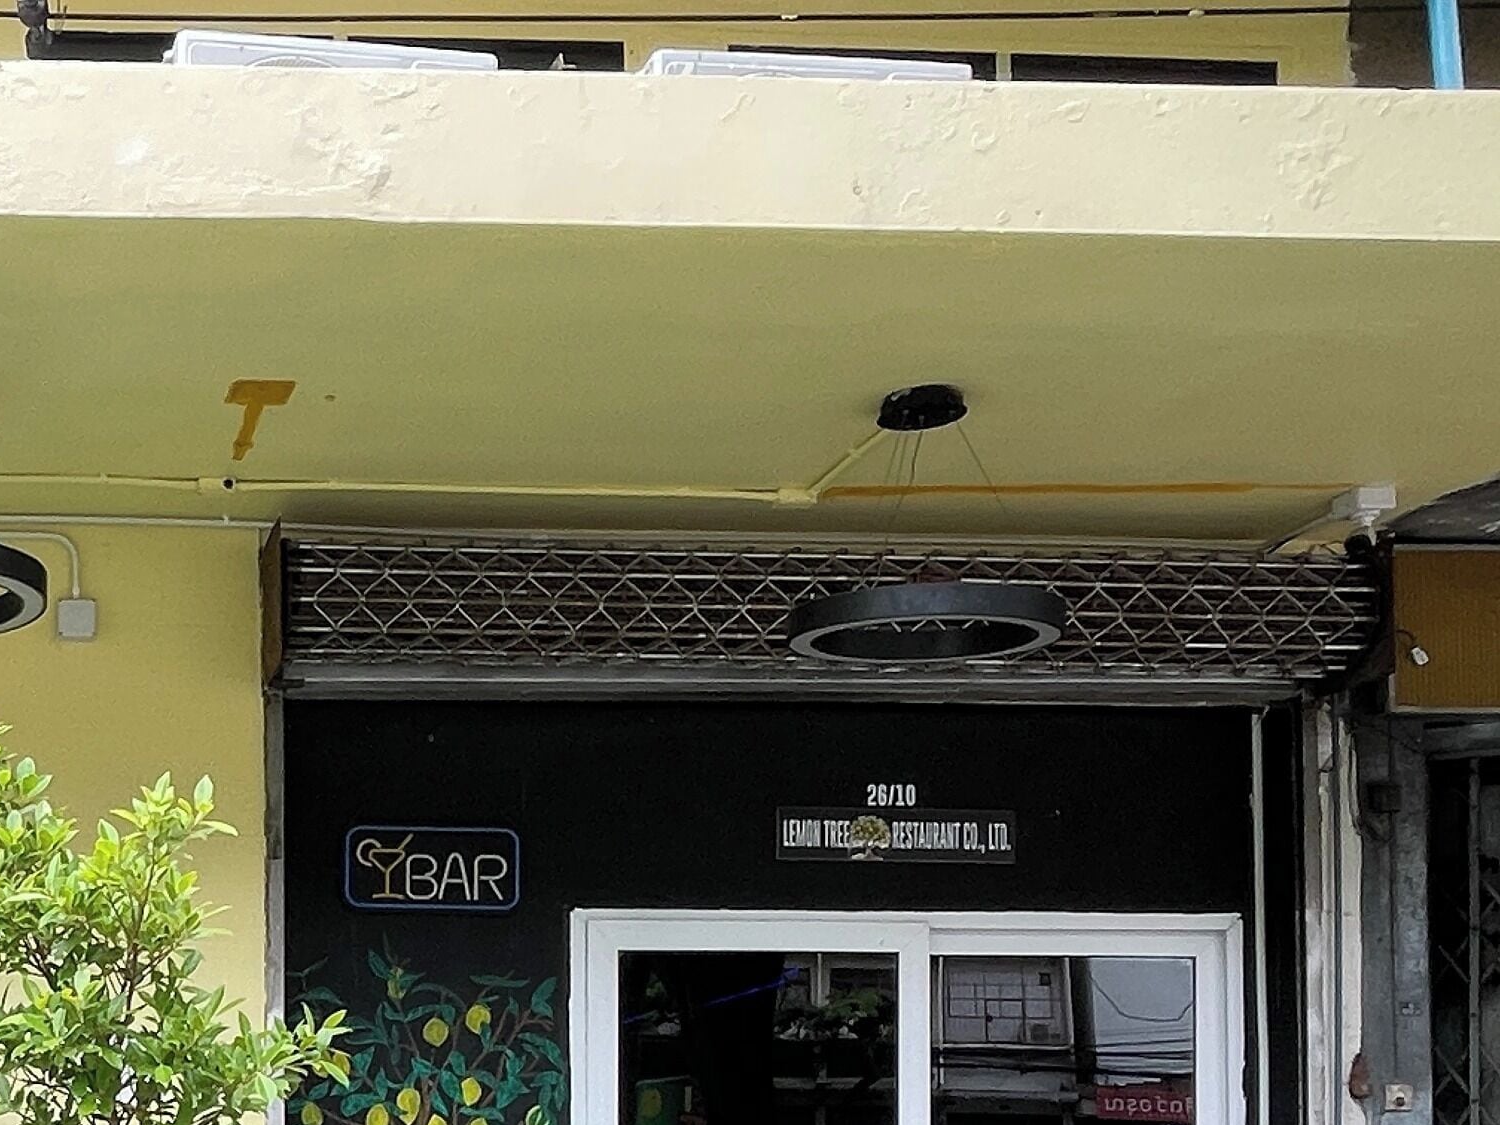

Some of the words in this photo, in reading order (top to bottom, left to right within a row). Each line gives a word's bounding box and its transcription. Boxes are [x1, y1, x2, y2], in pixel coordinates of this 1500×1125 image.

[866, 783, 917, 807] 26/10
[783, 819, 822, 848] LEMON
[823, 820, 850, 849] TREE
[891, 821, 961, 850] RESTAURANT
[988, 823, 1012, 851] LTD.
[405, 852, 508, 901] BAR
